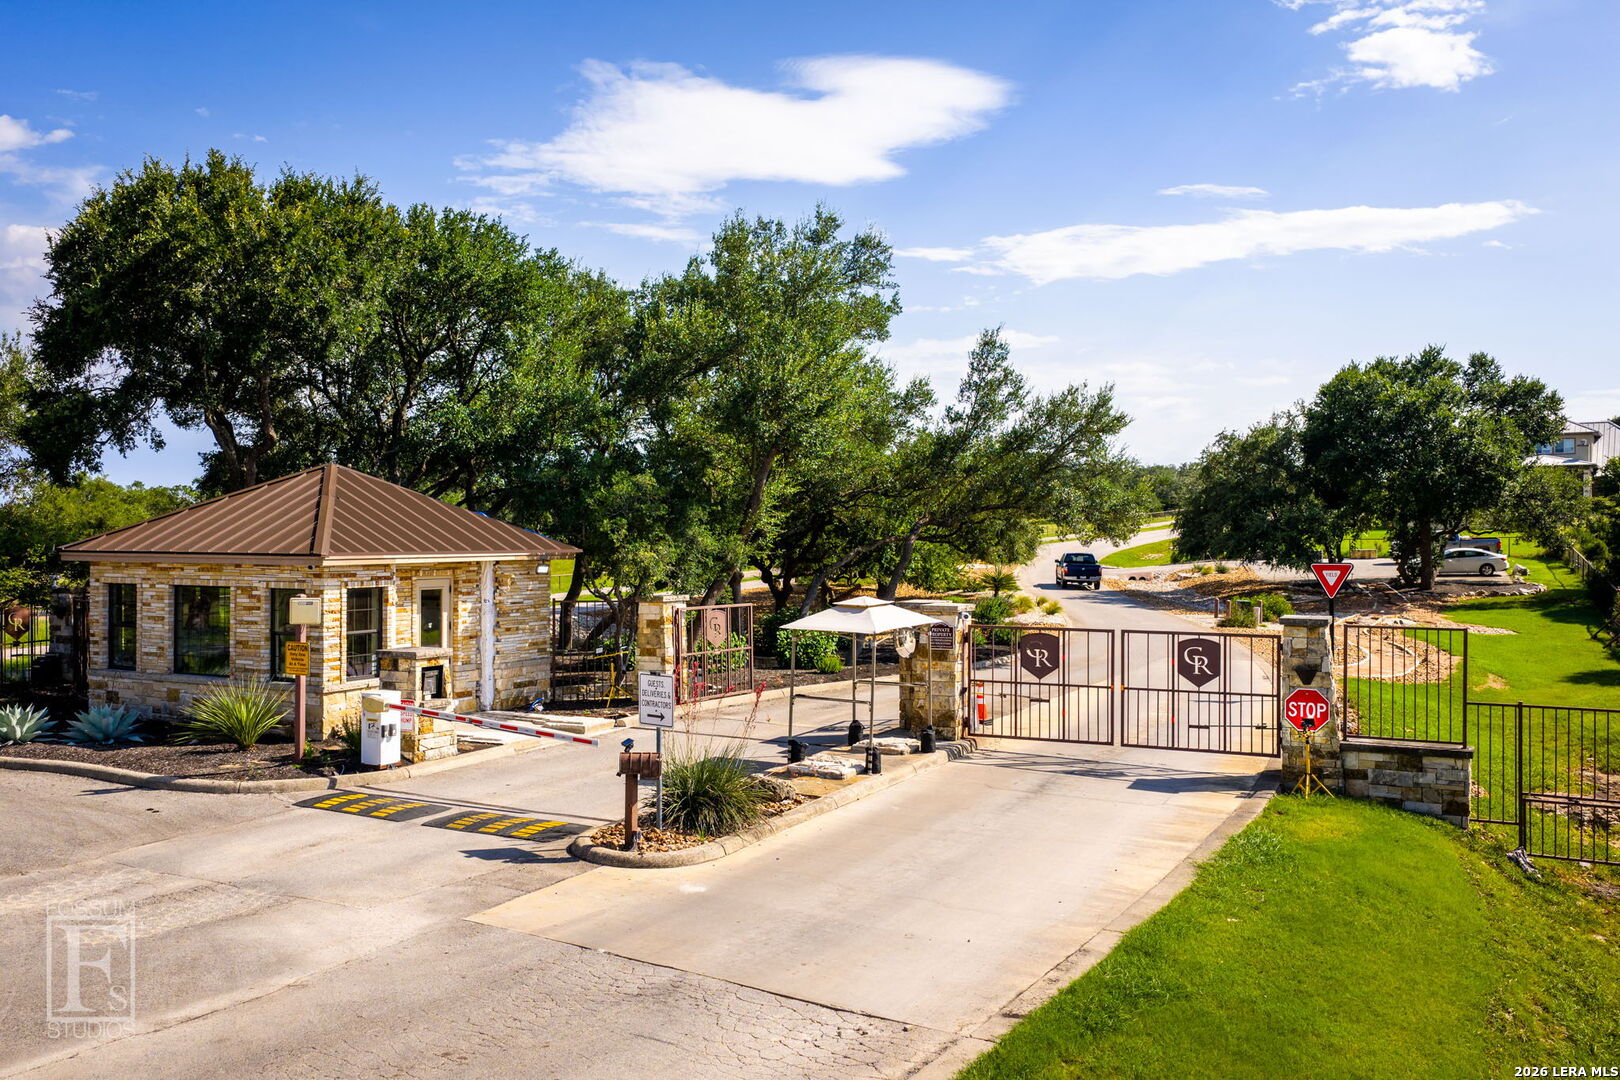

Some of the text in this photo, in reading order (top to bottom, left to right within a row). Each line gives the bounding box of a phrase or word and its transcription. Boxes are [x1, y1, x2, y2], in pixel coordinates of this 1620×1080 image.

[287, 644, 308, 652] CAUTION
[641, 689, 667, 699] DELIVERIES
[641, 699, 672, 709] CONTRACTORS
[1288, 701, 1327, 719] STOP
